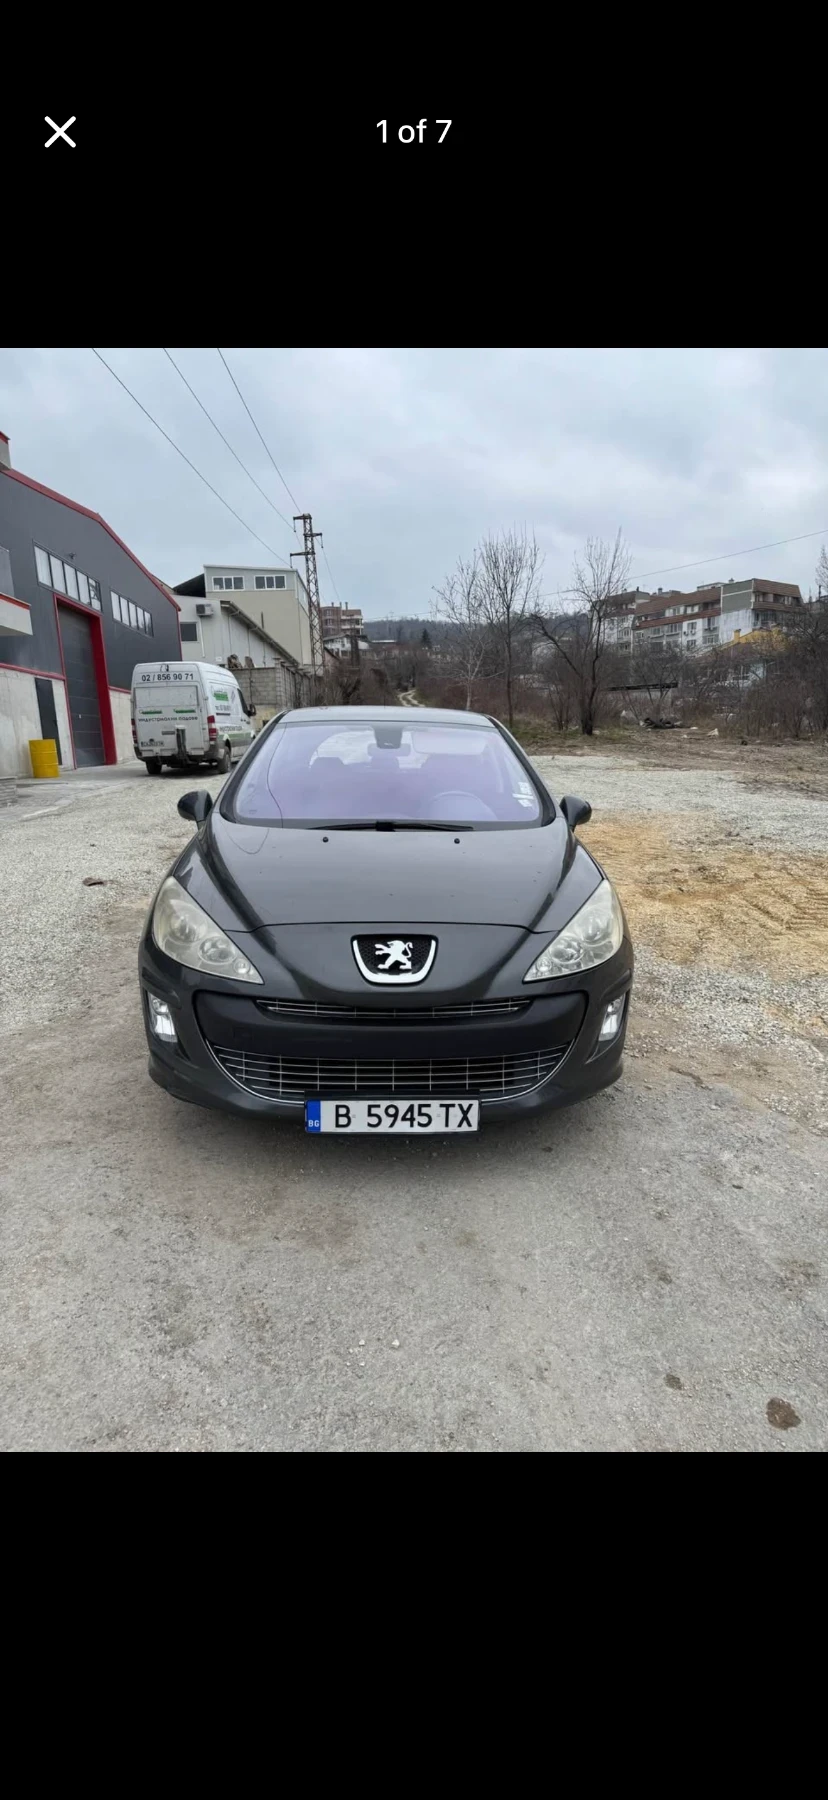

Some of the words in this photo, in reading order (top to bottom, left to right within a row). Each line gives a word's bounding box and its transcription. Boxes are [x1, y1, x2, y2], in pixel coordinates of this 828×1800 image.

[141, 674, 151, 682] 02
[157, 673, 171, 681] 856
[173, 673, 183, 681] 90
[335, 1104, 351, 1128] B
[367, 1103, 432, 1128] 5945
[439, 1103, 474, 1128] TX
[308, 1120, 319, 1128] BG
